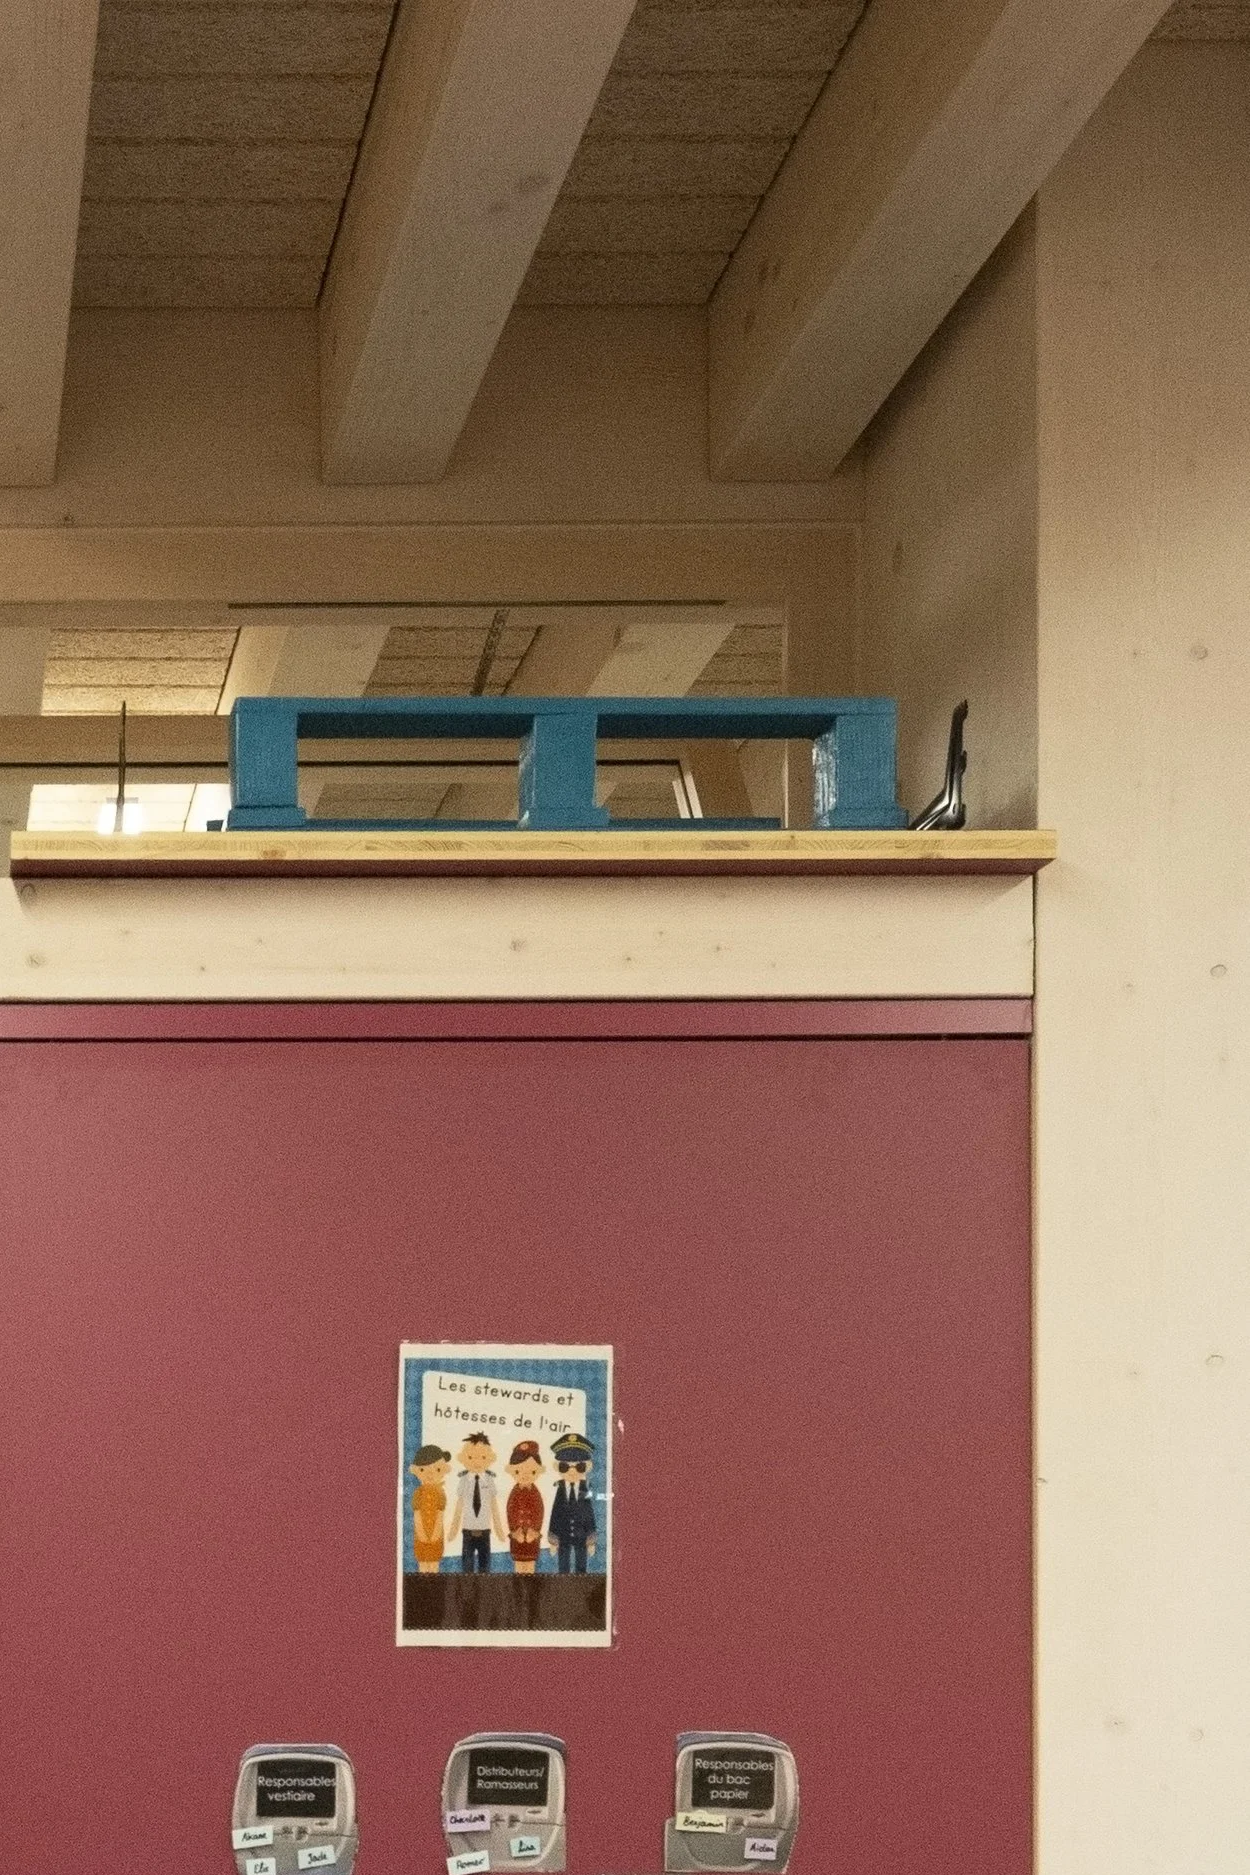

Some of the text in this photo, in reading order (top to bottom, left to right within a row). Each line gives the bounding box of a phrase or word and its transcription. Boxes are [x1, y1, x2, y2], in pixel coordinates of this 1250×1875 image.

[438, 1376, 575, 1407] Les stewards et
[434, 1402, 572, 1434] hôtesses de l'air
[694, 1757, 775, 1772] Responsables
[476, 1765, 545, 1778] Distributeurs/
[257, 1775, 337, 1789] Responsables
[476, 1779, 539, 1791] Ramasseurs
[707, 1773, 751, 1785] du bac
[267, 1790, 316, 1802] vestiaire
[709, 1788, 749, 1801] papier
